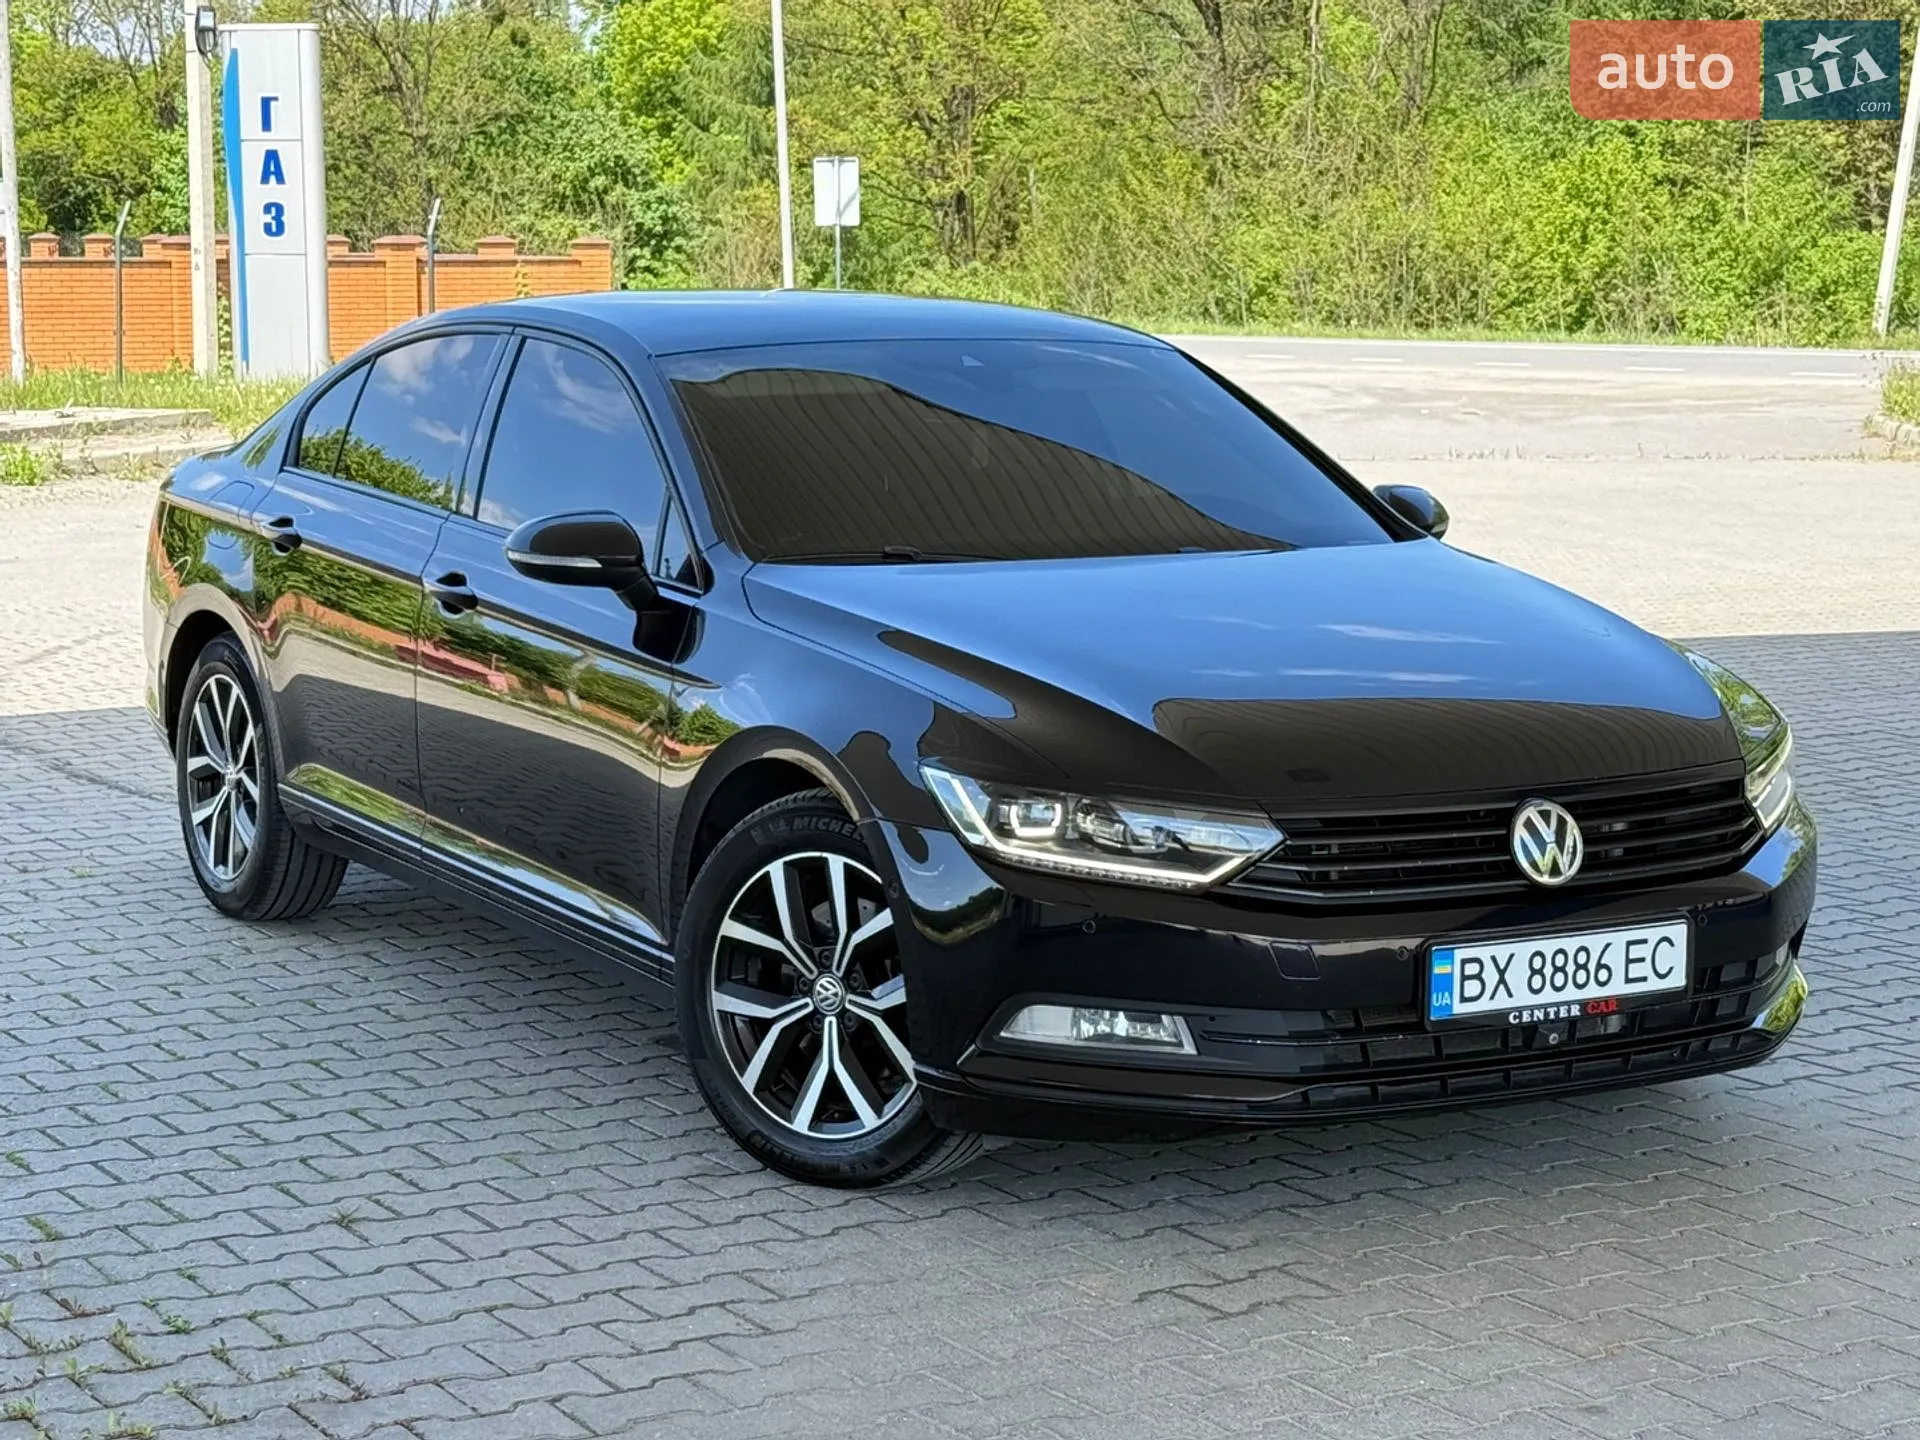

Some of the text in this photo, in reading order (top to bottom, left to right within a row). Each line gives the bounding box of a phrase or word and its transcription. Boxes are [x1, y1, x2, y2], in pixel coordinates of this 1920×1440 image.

[259, 96, 287, 238] ГАЗ
[1459, 935, 1676, 1004] BX 8886 EC
[1432, 992, 1451, 1007] UA
[1508, 998, 1619, 1024] CENTER CAR
